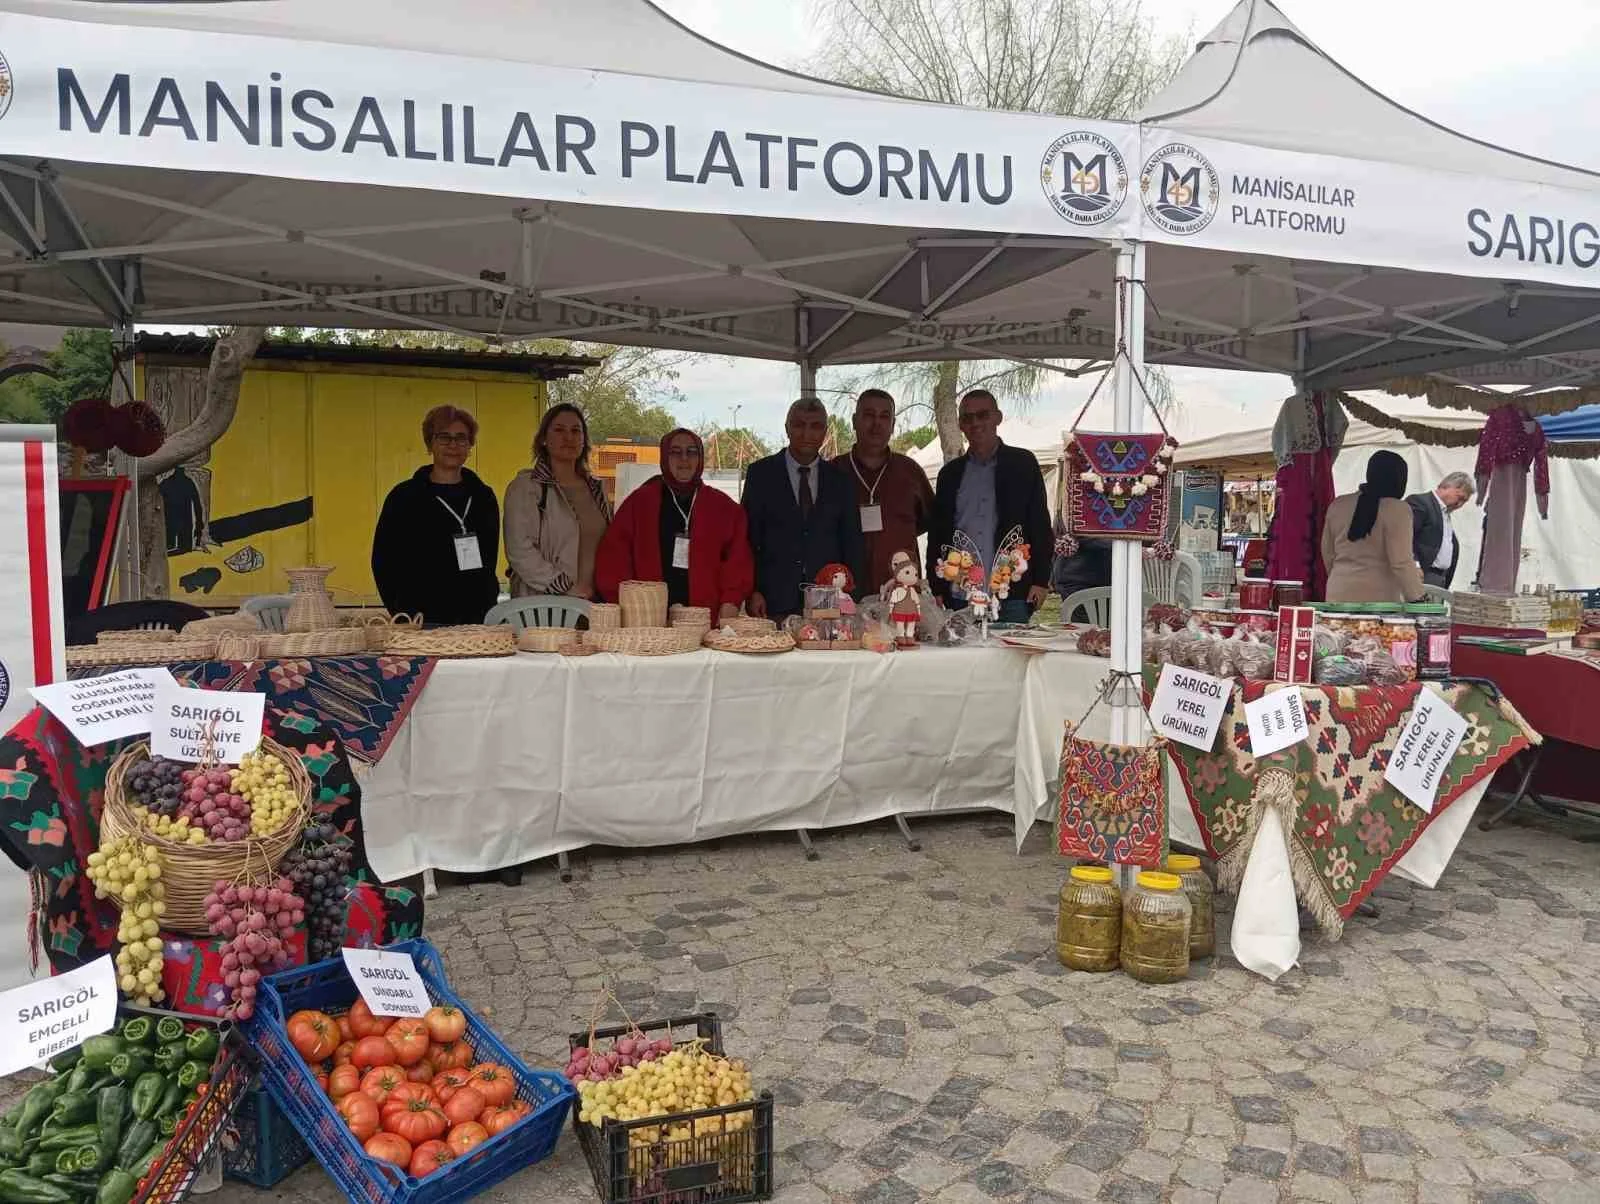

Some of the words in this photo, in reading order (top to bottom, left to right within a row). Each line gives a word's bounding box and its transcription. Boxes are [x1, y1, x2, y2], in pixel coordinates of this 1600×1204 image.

[57, 67, 597, 175] MANİSALILAR
[621, 120, 1013, 205] PLATFORMU
[1232, 175, 1355, 208] MANİSALILAR
[1232, 205, 1346, 235] PLATFORMU
[1467, 208, 1600, 268] SARIG
[1172, 674, 1222, 699] SARIGÖL
[171, 704, 245, 723] SARIGÖL
[1177, 698, 1206, 718] YEREL
[1287, 694, 1303, 733] SARIGÖL
[170, 727, 241, 743] SULTANİYE
[1162, 714, 1209, 739] ÜRÜNLERİ
[1394, 705, 1433, 771] SARIGÖL
[1413, 729, 1440, 769] YEREL
[18, 986, 99, 1023] SARIGÖL
[29, 1009, 90, 1043] EMCELLİ
[38, 1032, 79, 1059] BİBERİ
